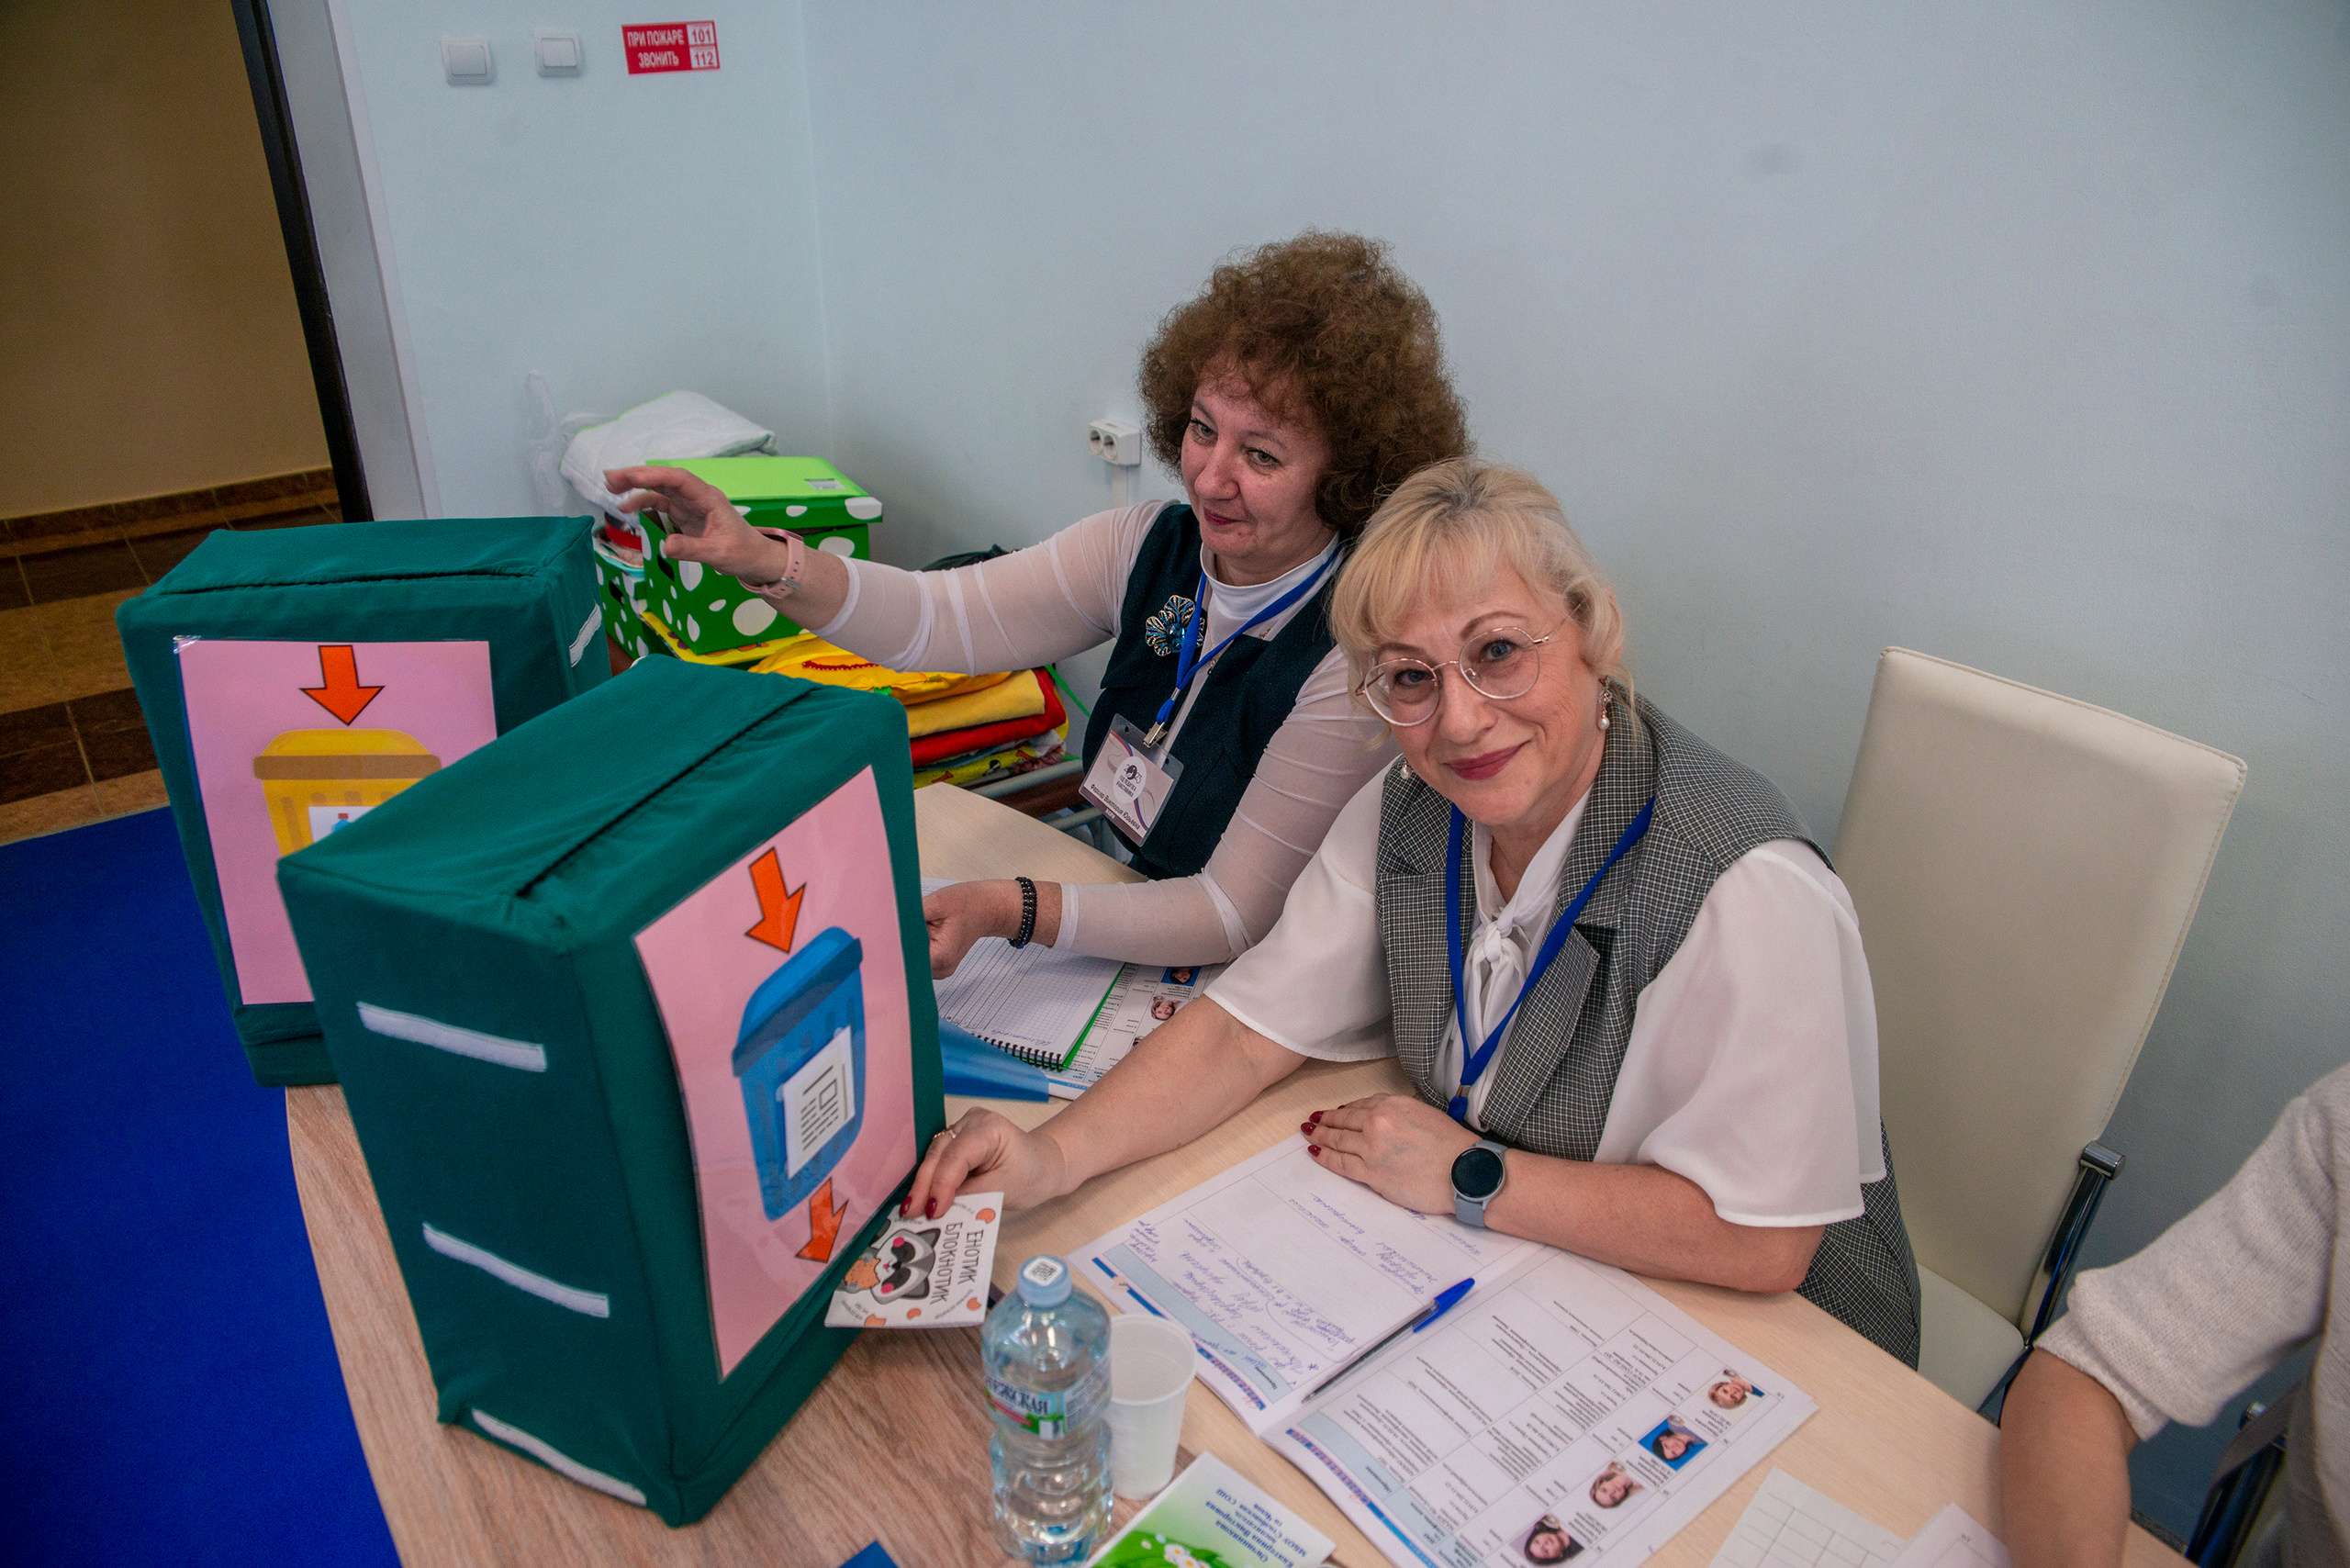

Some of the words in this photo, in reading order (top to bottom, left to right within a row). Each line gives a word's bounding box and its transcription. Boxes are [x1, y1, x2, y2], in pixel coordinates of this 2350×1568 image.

[627, 31, 646, 47] ПРИ
[646, 29, 685, 46] ПОЖАРЕ
[691, 28, 711, 43] 101
[638, 50, 679, 68] ЗВОНИТЬ
[695, 51, 713, 66] 112
[930, 1221, 964, 1305] БЛОКНОТИК
[957, 1228, 984, 1285] ЕНОТИК
[1203, 1498, 1252, 1538] Викторовна
[1214, 1518, 1269, 1562] Овчинникова
[1249, 1533, 1294, 1568] Екатерина
